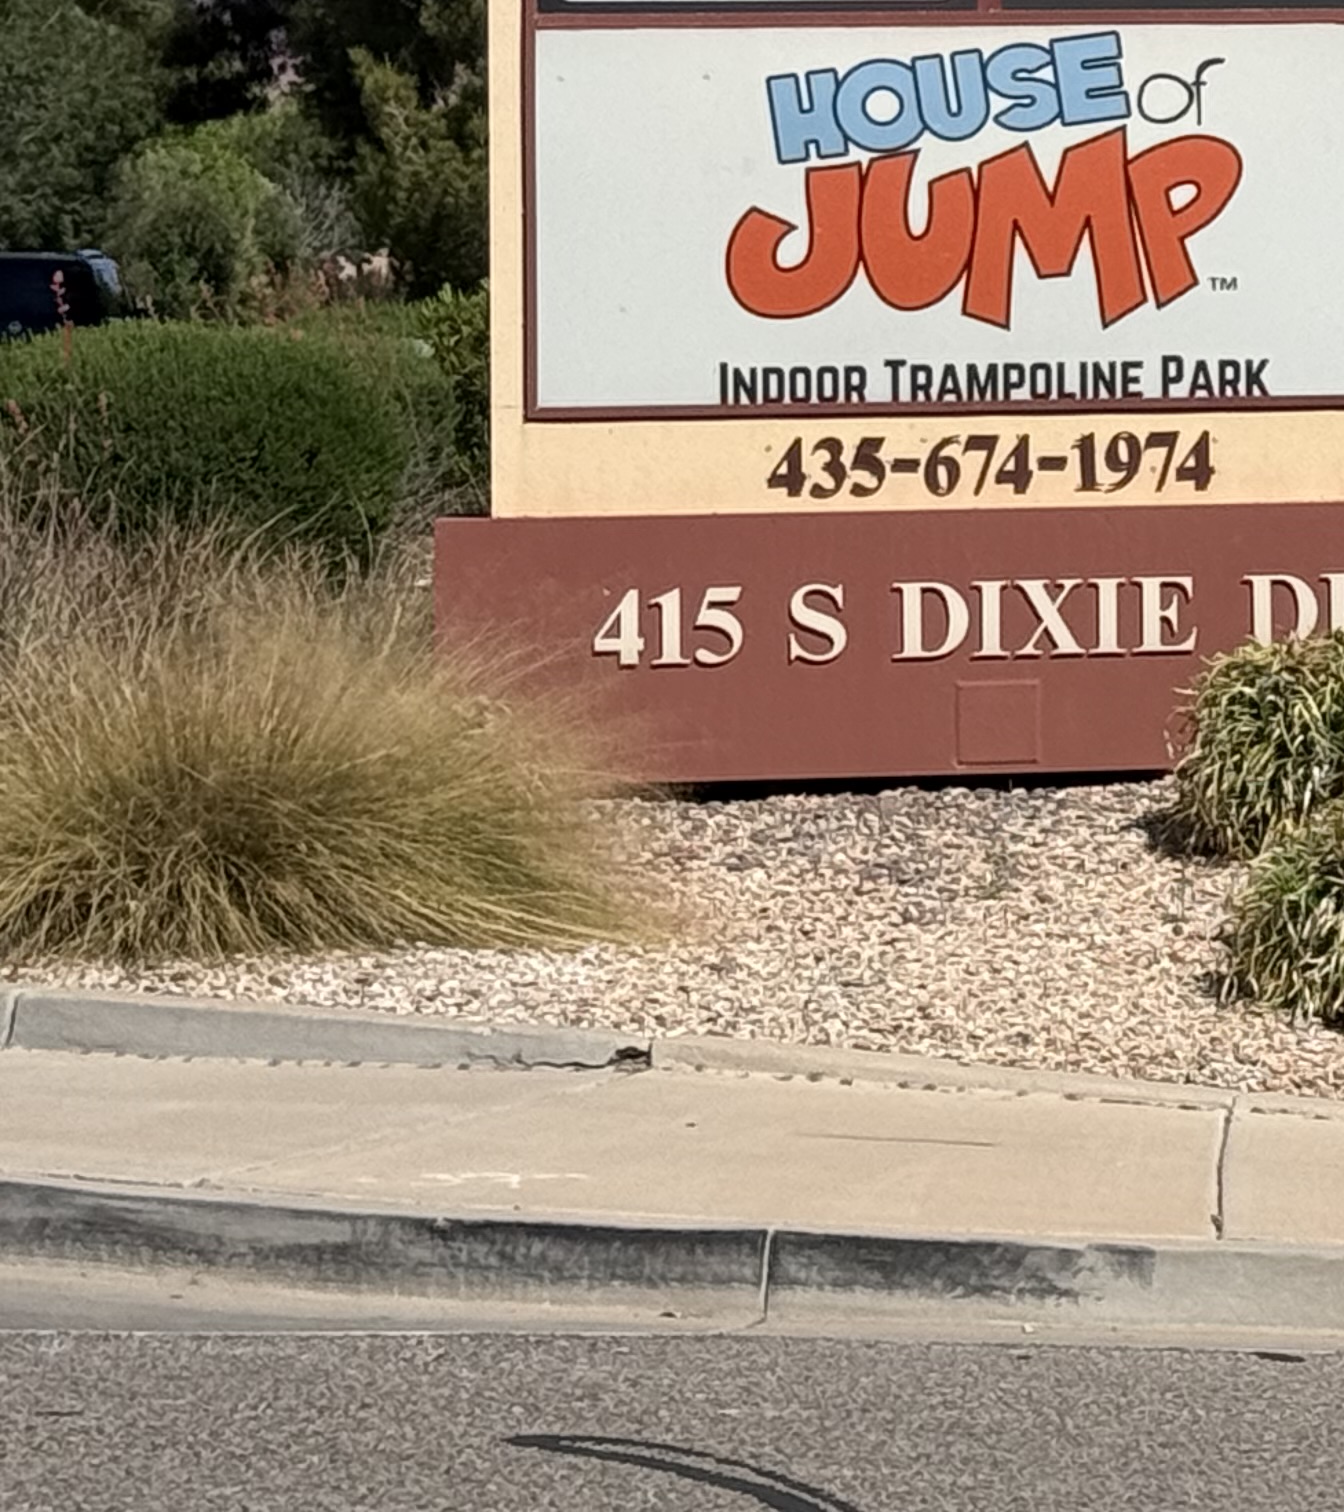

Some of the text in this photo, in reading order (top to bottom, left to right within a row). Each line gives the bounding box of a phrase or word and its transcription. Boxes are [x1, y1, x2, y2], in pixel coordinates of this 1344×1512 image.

[766, 31, 1225, 164] HOUSE of
[725, 125, 1243, 331] JUMP
[766, 430, 1216, 498] 435-674-1974
[594, 586, 744, 664] 415
[789, 583, 847, 662] S
[892, 576, 1197, 659] DIXIE
